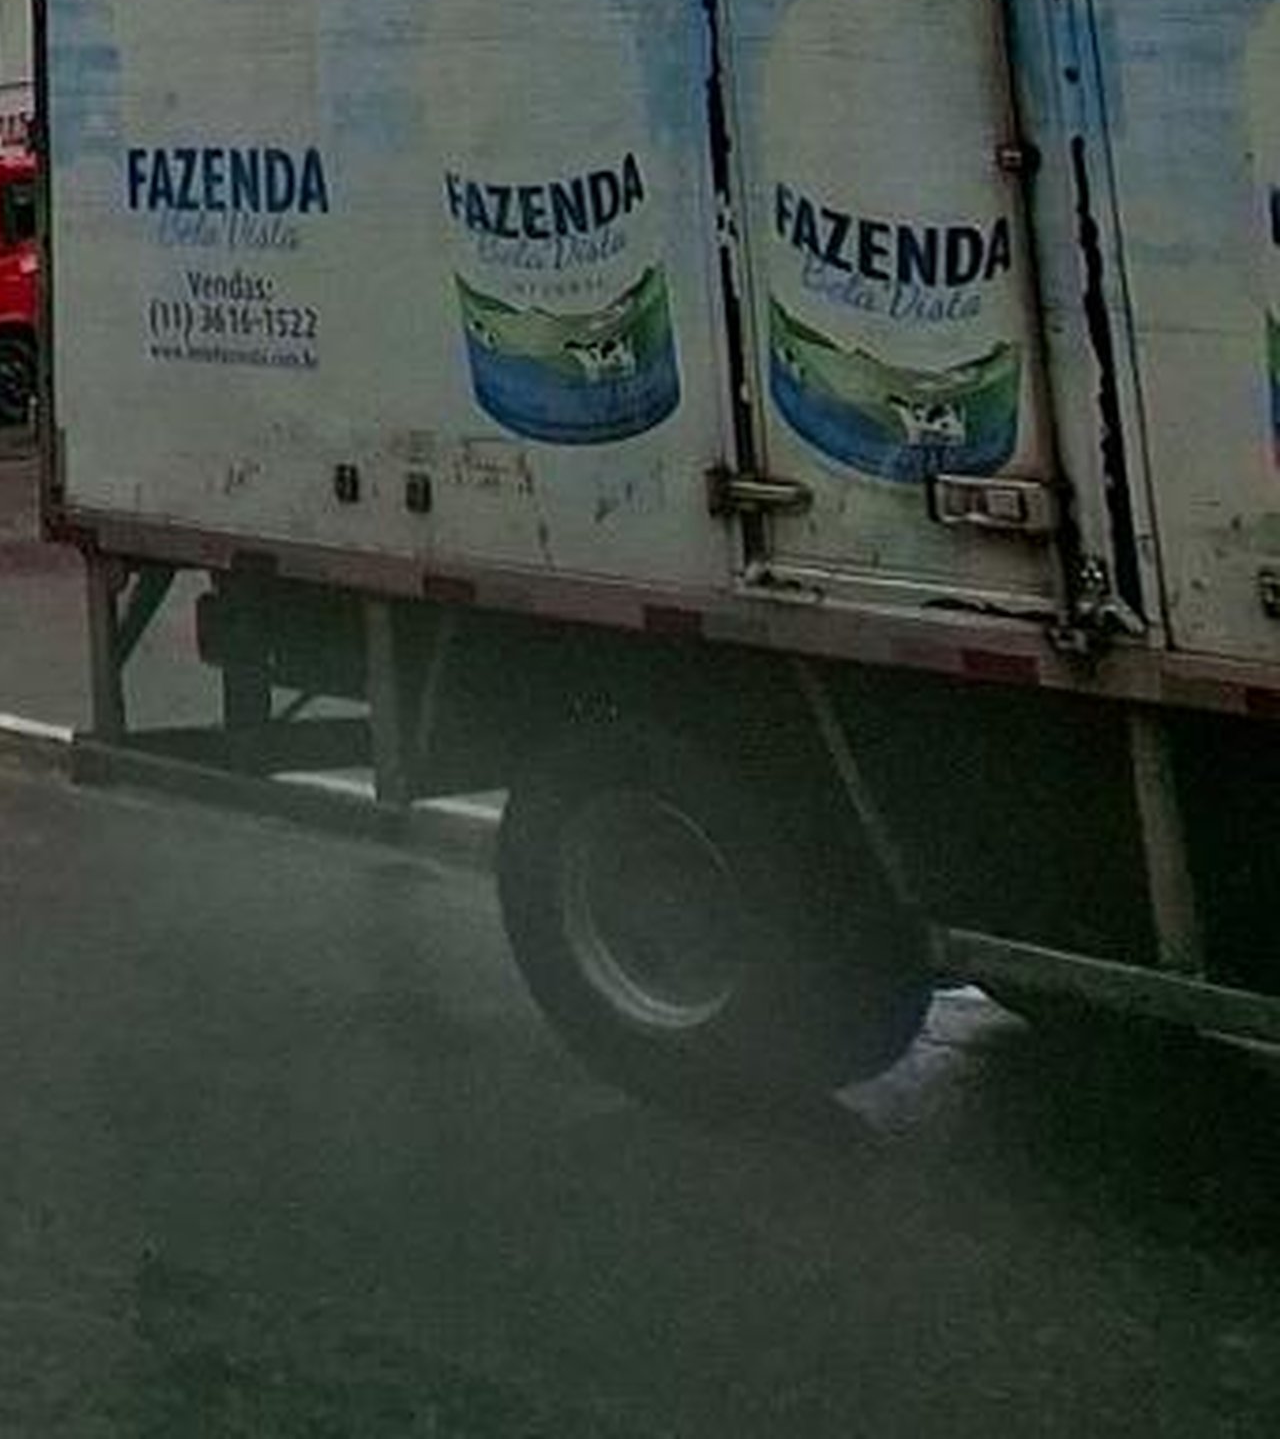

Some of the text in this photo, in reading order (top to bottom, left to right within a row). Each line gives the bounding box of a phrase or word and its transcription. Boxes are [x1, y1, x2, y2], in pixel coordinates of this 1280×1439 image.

[128, 147, 329, 214] FAZENDA
[446, 152, 644, 240] FAZENDA
[776, 182, 1013, 287] FAZENDA
[187, 269, 274, 301] Vendas:
[148, 299, 194, 343] (11)
